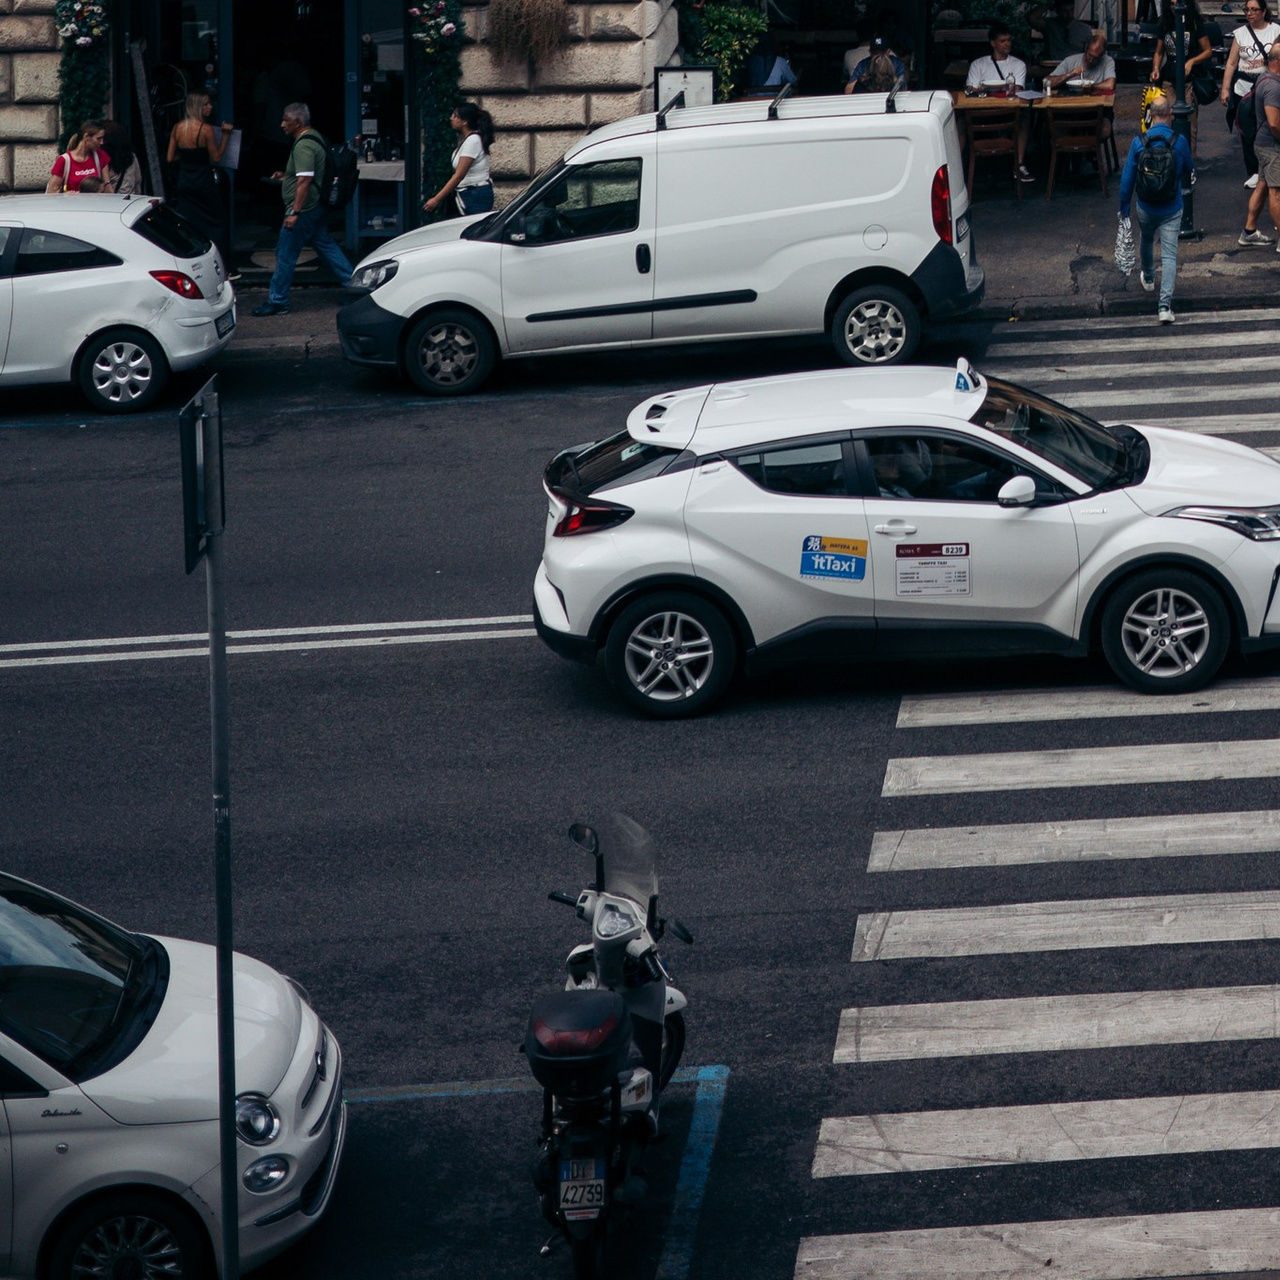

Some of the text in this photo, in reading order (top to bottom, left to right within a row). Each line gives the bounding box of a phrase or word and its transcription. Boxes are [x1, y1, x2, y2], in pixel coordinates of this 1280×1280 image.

[945, 546, 963, 554] 8239
[811, 554, 856, 573] itTaxi
[562, 1183, 603, 1205] 42739
